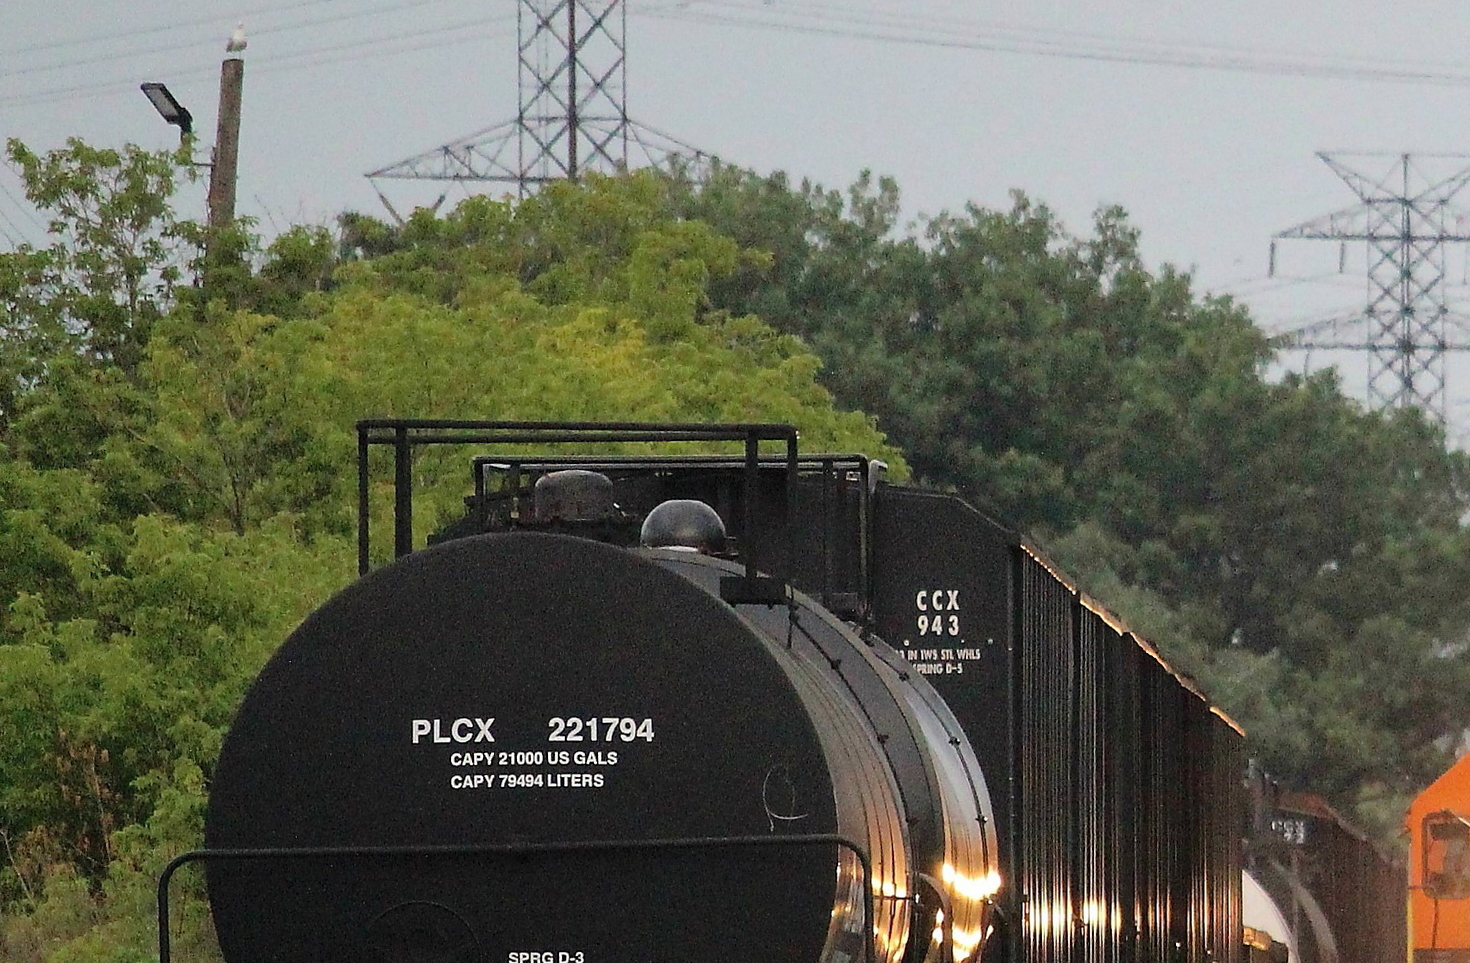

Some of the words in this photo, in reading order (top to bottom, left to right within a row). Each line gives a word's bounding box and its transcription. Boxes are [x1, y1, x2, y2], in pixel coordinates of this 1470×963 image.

[916, 590, 960, 611] CCX
[917, 615, 959, 636] 943
[908, 650, 918, 660] IN
[941, 649, 955, 660] STL
[957, 649, 980, 660] WHLS
[946, 663, 963, 674] D-5
[412, 718, 495, 743] PLCX
[548, 718, 655, 742] 221794
[450, 752, 494, 766] CAPY
[499, 752, 543, 765] 21000
[547, 751, 570, 765] US
[573, 751, 618, 765] GALS
[450, 775, 494, 788] CAPY
[499, 775, 543, 788] 79494
[547, 774, 604, 787] LITERS
